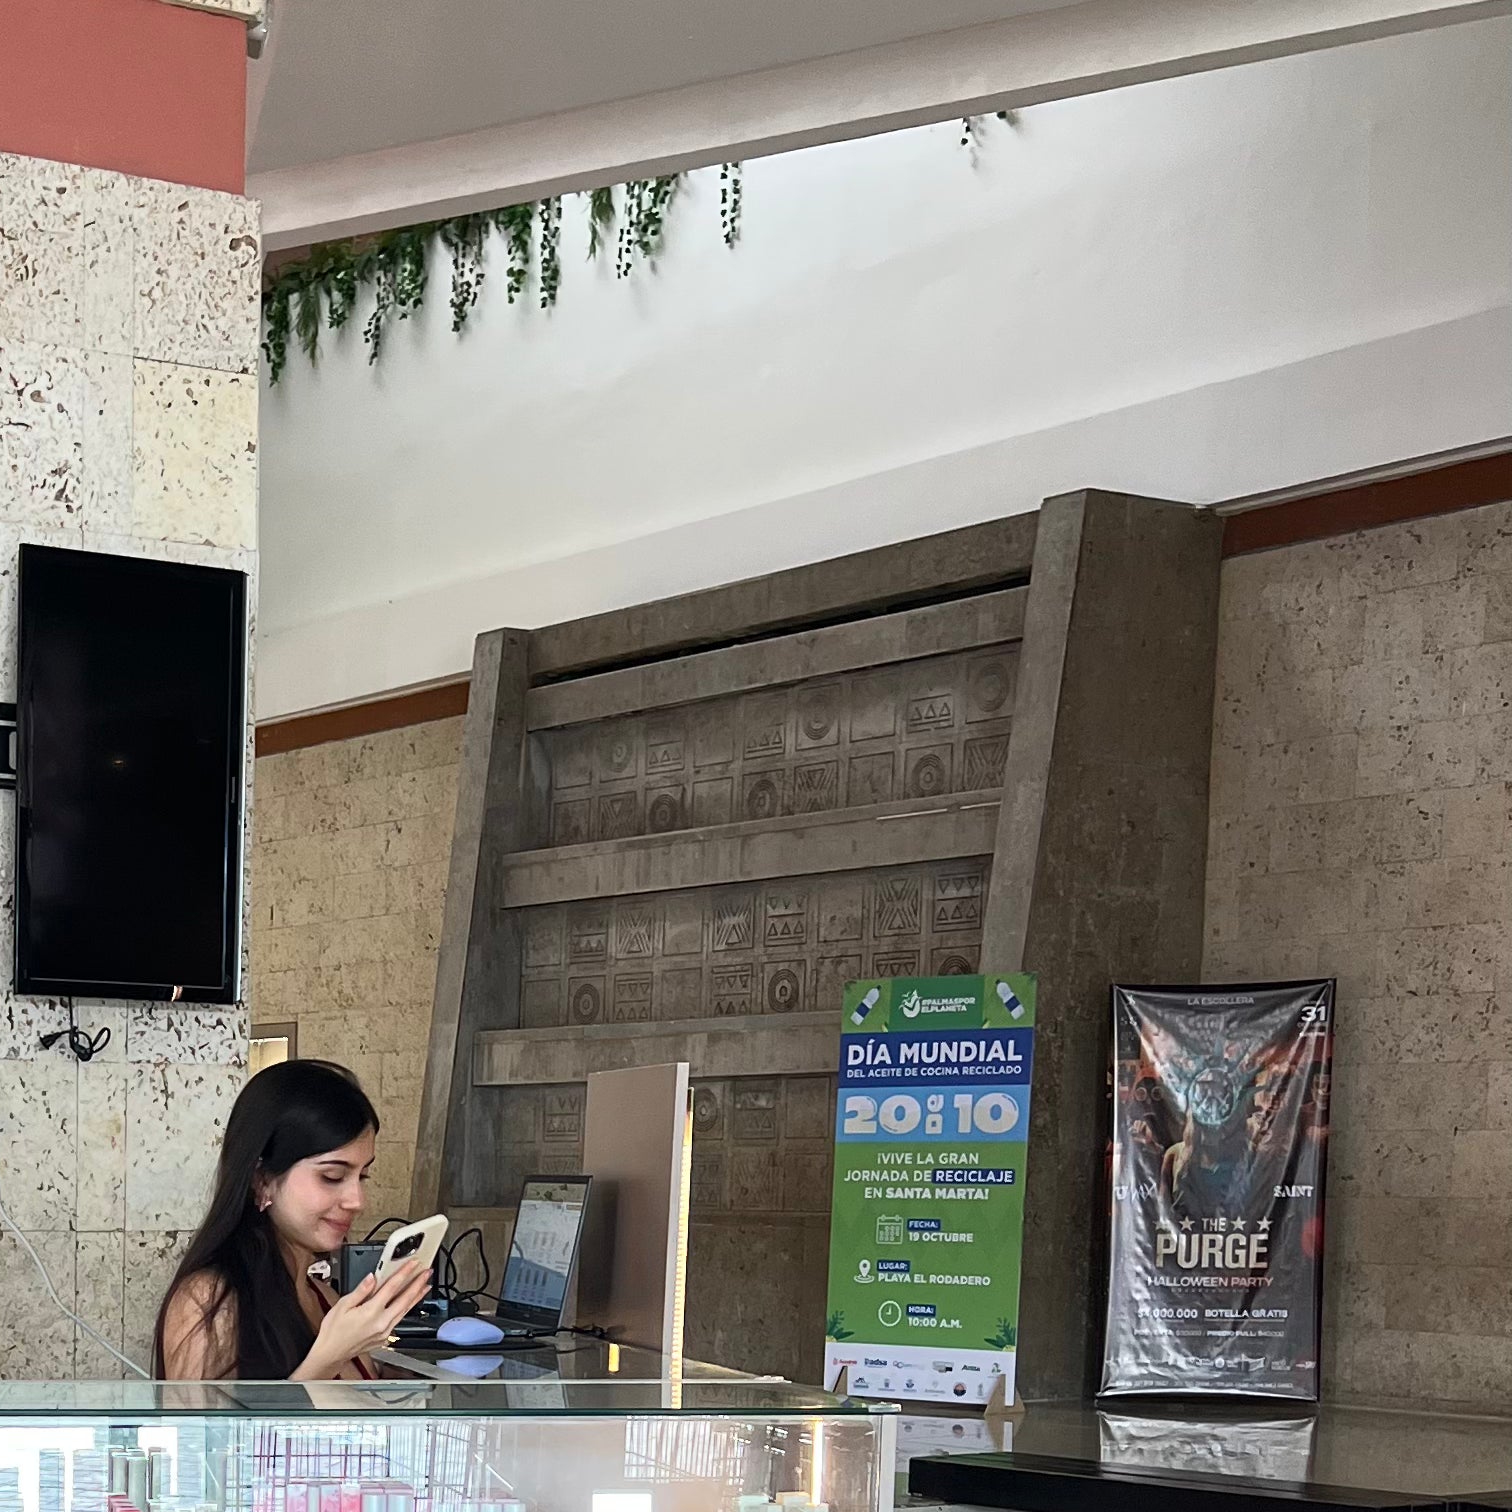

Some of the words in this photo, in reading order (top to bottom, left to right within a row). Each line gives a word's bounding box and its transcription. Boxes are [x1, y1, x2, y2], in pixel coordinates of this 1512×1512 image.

[1301, 1005, 1327, 1022] 31
[847, 1038, 892, 1066] DÍA
[899, 1039, 1023, 1064] MUNDIAL
[846, 1069, 865, 1078] DEL
[867, 1068, 902, 1077] ACEITE
[904, 1067, 918, 1076] DE
[920, 1066, 960, 1076] COCINA
[962, 1065, 1022, 1075] RECICLADO
[843, 1094, 921, 1134] 20
[953, 1092, 1019, 1134] 10
[917, 1153, 935, 1165] LA
[939, 1153, 979, 1165] GRAN
[844, 1170, 909, 1182] JORNADA
[913, 1170, 932, 1182] DE
[935, 1170, 1014, 1183] RECICLAJE
[864, 1187, 882, 1199] EN
[885, 1187, 932, 1199] SANTA
[935, 1187, 990, 1200] MARTA!
[908, 1220, 939, 1229] FECHA:
[1202, 1217, 1227, 1232] THE
[908, 1232, 920, 1242] 19
[923, 1232, 974, 1243] OCTUBRE
[1155, 1233, 1269, 1269] PURGE
[877, 1272, 911, 1283] PLAYA
[913, 1274, 927, 1284] EL
[929, 1274, 991, 1286] RODADERO
[1147, 1277, 1228, 1288] HALLOWEEN
[1230, 1277, 1274, 1287] PARTY
[1204, 1309, 1249, 1318] BOTELLA
[1251, 1309, 1288, 1318] GRATIS
[908, 1317, 938, 1328] 10:00
[939, 1319, 963, 1329] A.M.
